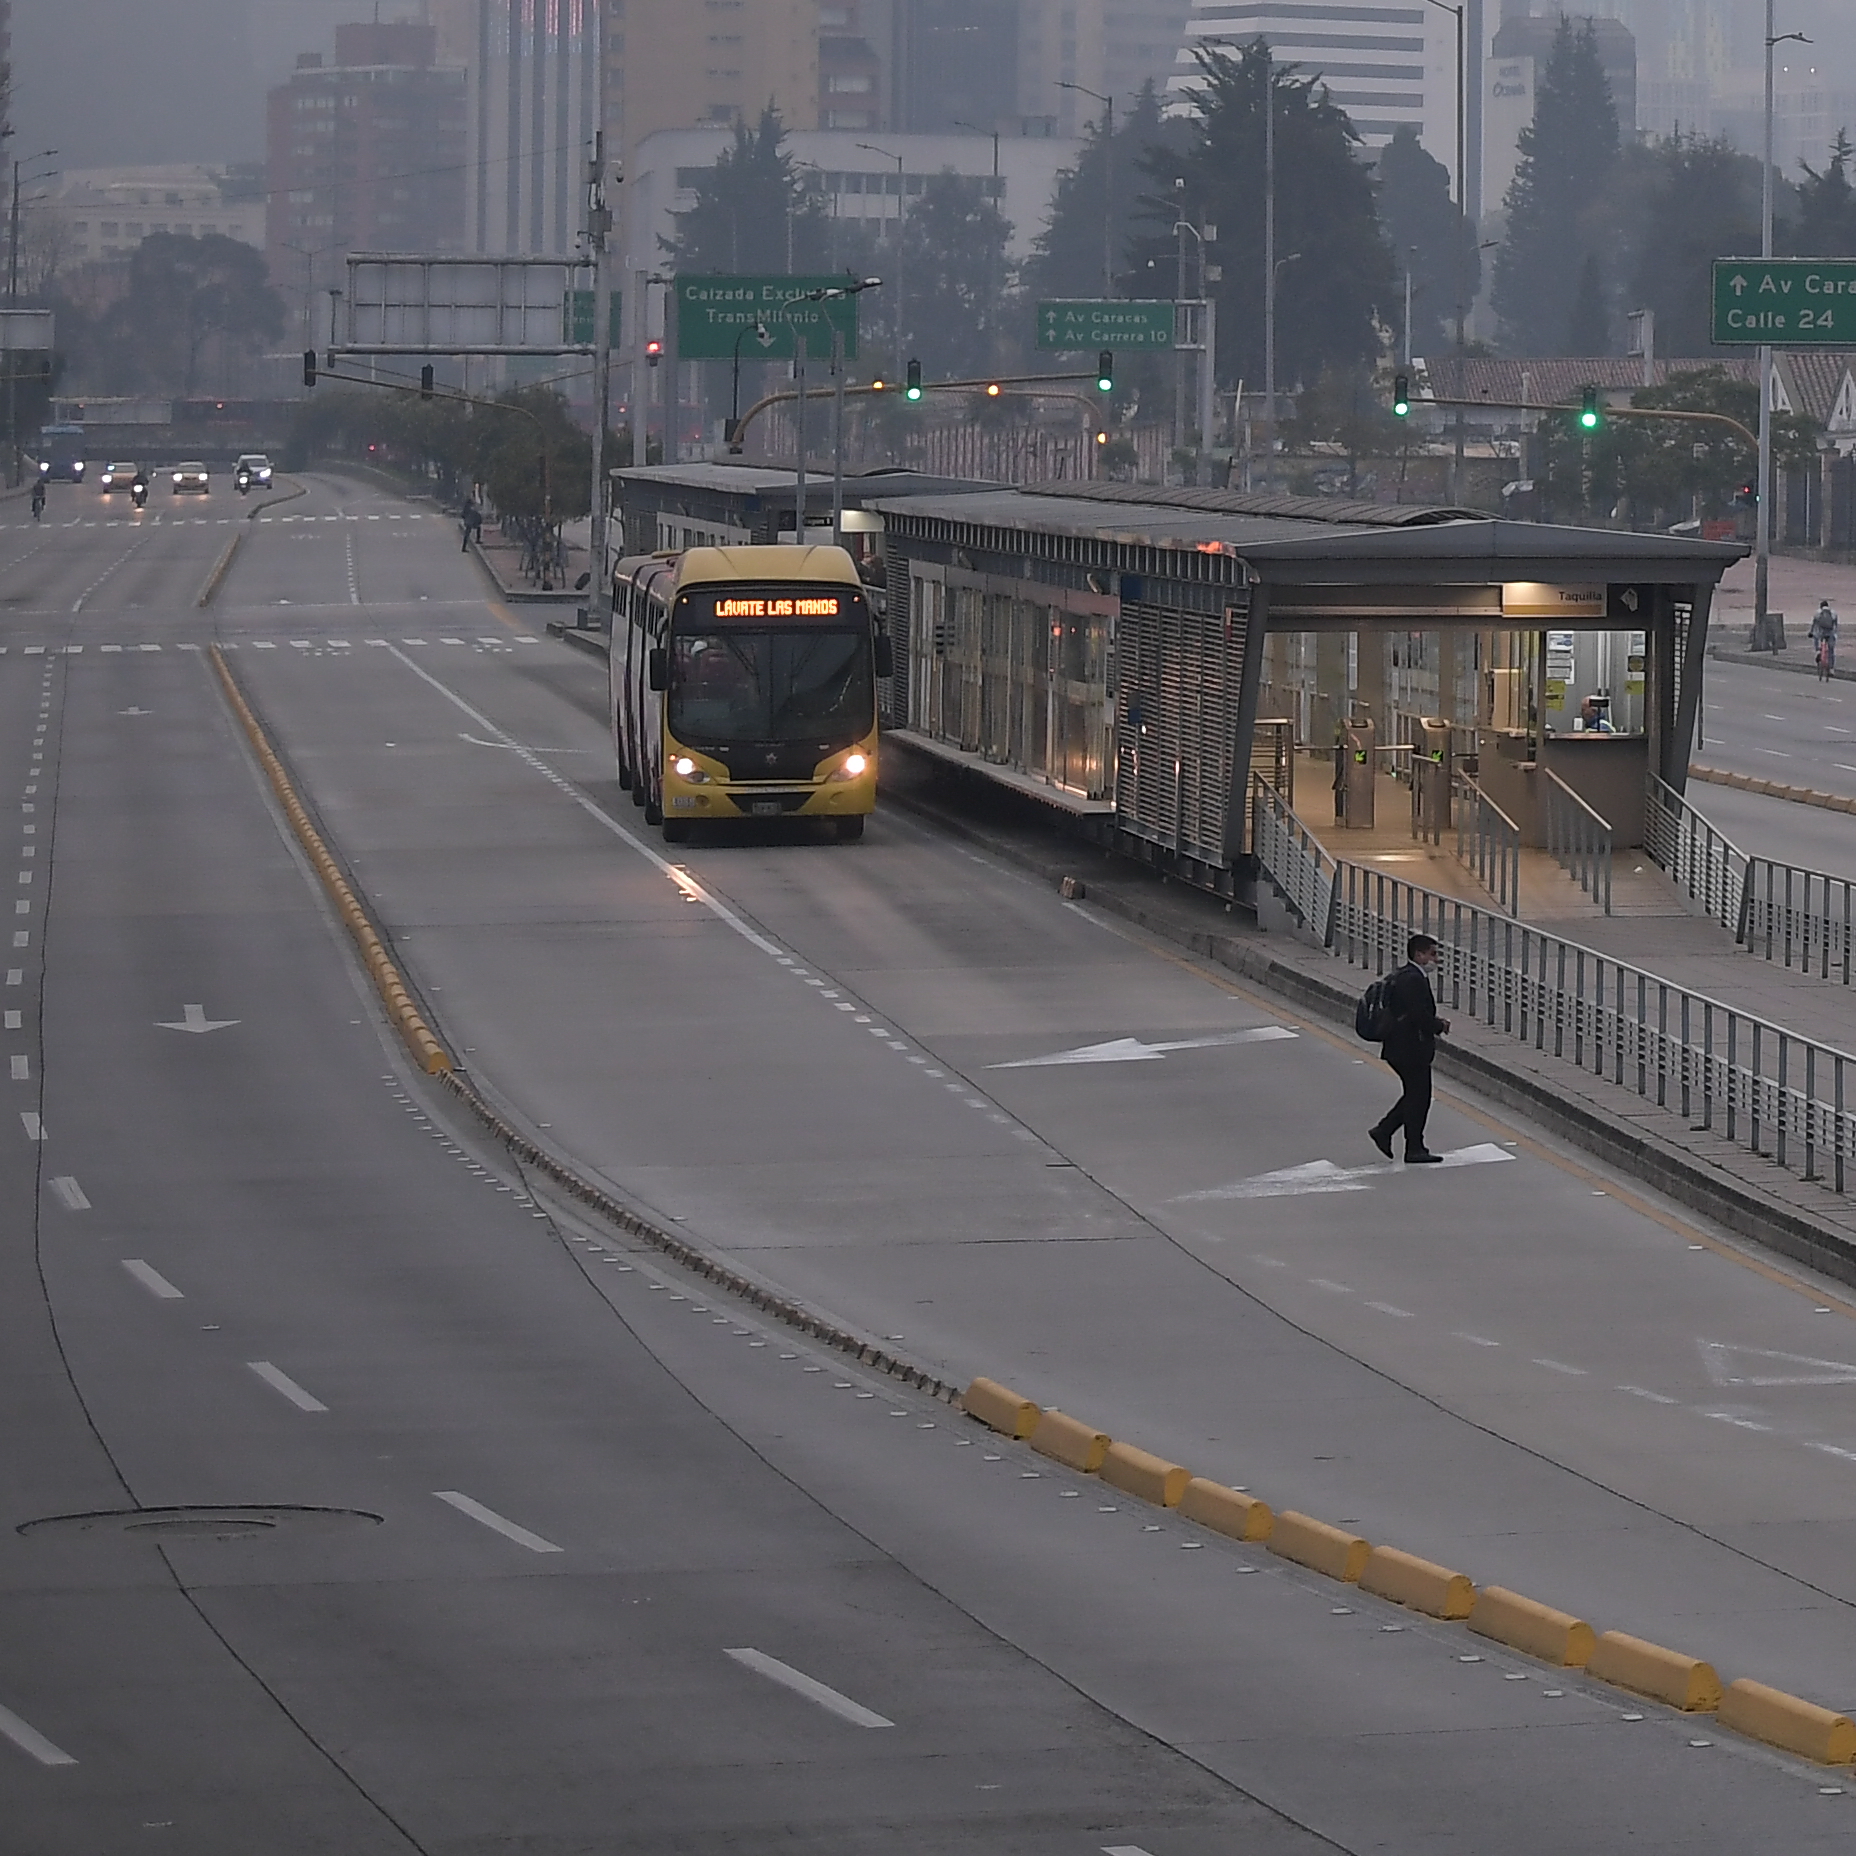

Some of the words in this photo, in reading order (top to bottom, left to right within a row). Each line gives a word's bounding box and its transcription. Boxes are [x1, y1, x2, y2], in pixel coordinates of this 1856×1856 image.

[1758, 274, 1792, 294] Av
[686, 285, 754, 300] Calzada
[706, 308, 820, 324] TransMilenio
[1065, 310, 1085, 323] Av
[1091, 311, 1148, 323] Caracas
[1727, 309, 1786, 329] Calle
[1798, 309, 1834, 329] 24
[1065, 329, 1084, 342] Av
[1091, 330, 1144, 342] Carrera
[1150, 330, 1167, 342] 10
[1558, 590, 1603, 603] Taquilla
[715, 598, 765, 617] LÁVATE
[767, 599, 793, 616] LAS
[794, 598, 838, 615] MANOS
